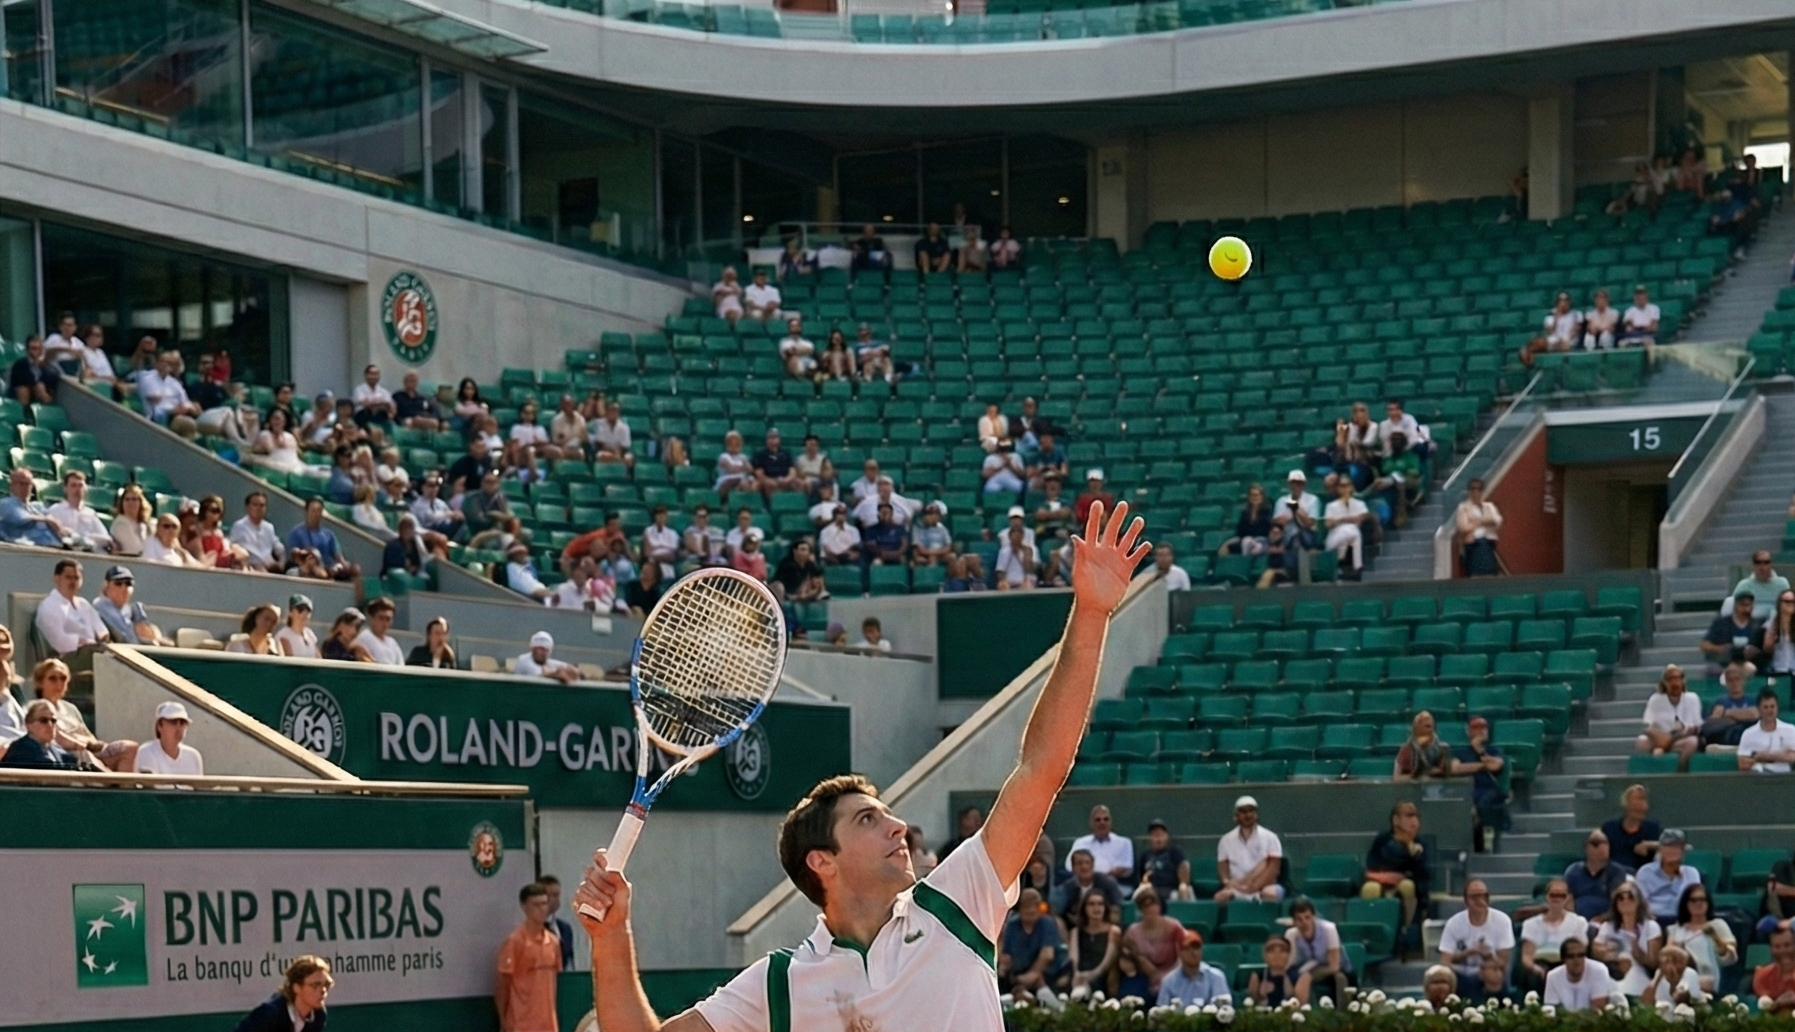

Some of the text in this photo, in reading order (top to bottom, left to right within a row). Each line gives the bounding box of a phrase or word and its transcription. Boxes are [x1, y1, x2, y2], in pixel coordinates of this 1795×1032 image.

[1629, 426, 1661, 450] 15
[380, 712, 699, 777] ROLAND-GAR
[164, 886, 445, 946] BNP PARIBAS
[167, 957, 189, 981] La
[195, 955, 253, 985] banqu
[402, 946, 444, 977] paris
